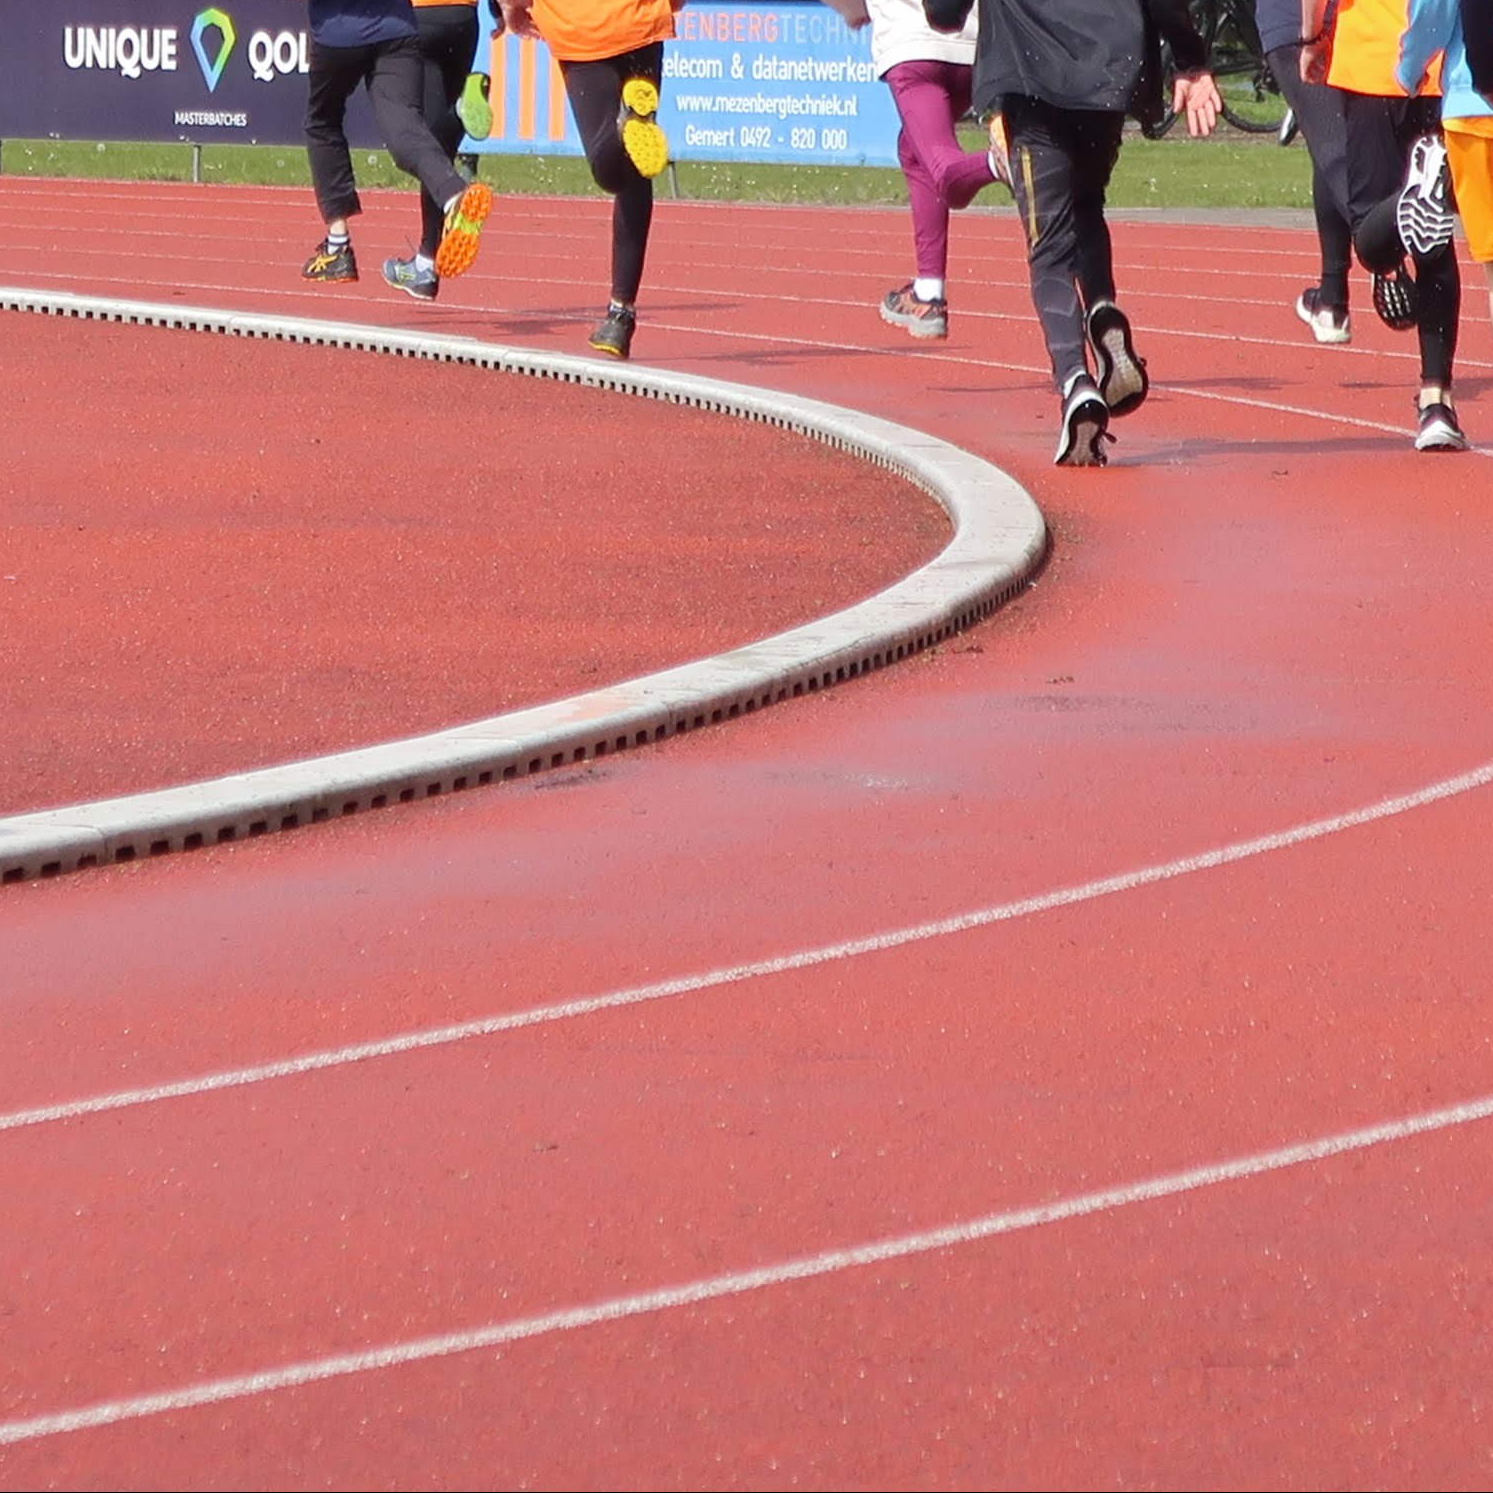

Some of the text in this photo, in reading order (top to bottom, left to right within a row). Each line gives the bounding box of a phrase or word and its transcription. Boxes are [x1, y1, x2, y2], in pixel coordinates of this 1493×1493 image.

[64, 27, 177, 79] UNIQUE
[730, 52, 745, 80] &
[753, 53, 879, 83] datanetwerken
[174, 111, 247, 127] MASTERBATCHES
[676, 92, 859, 120] www.mezenbergtechniek.nl
[685, 124, 735, 147] Gemert
[740, 126, 771, 149] 0492
[790, 127, 816, 150] 820
[821, 128, 848, 151] 000
